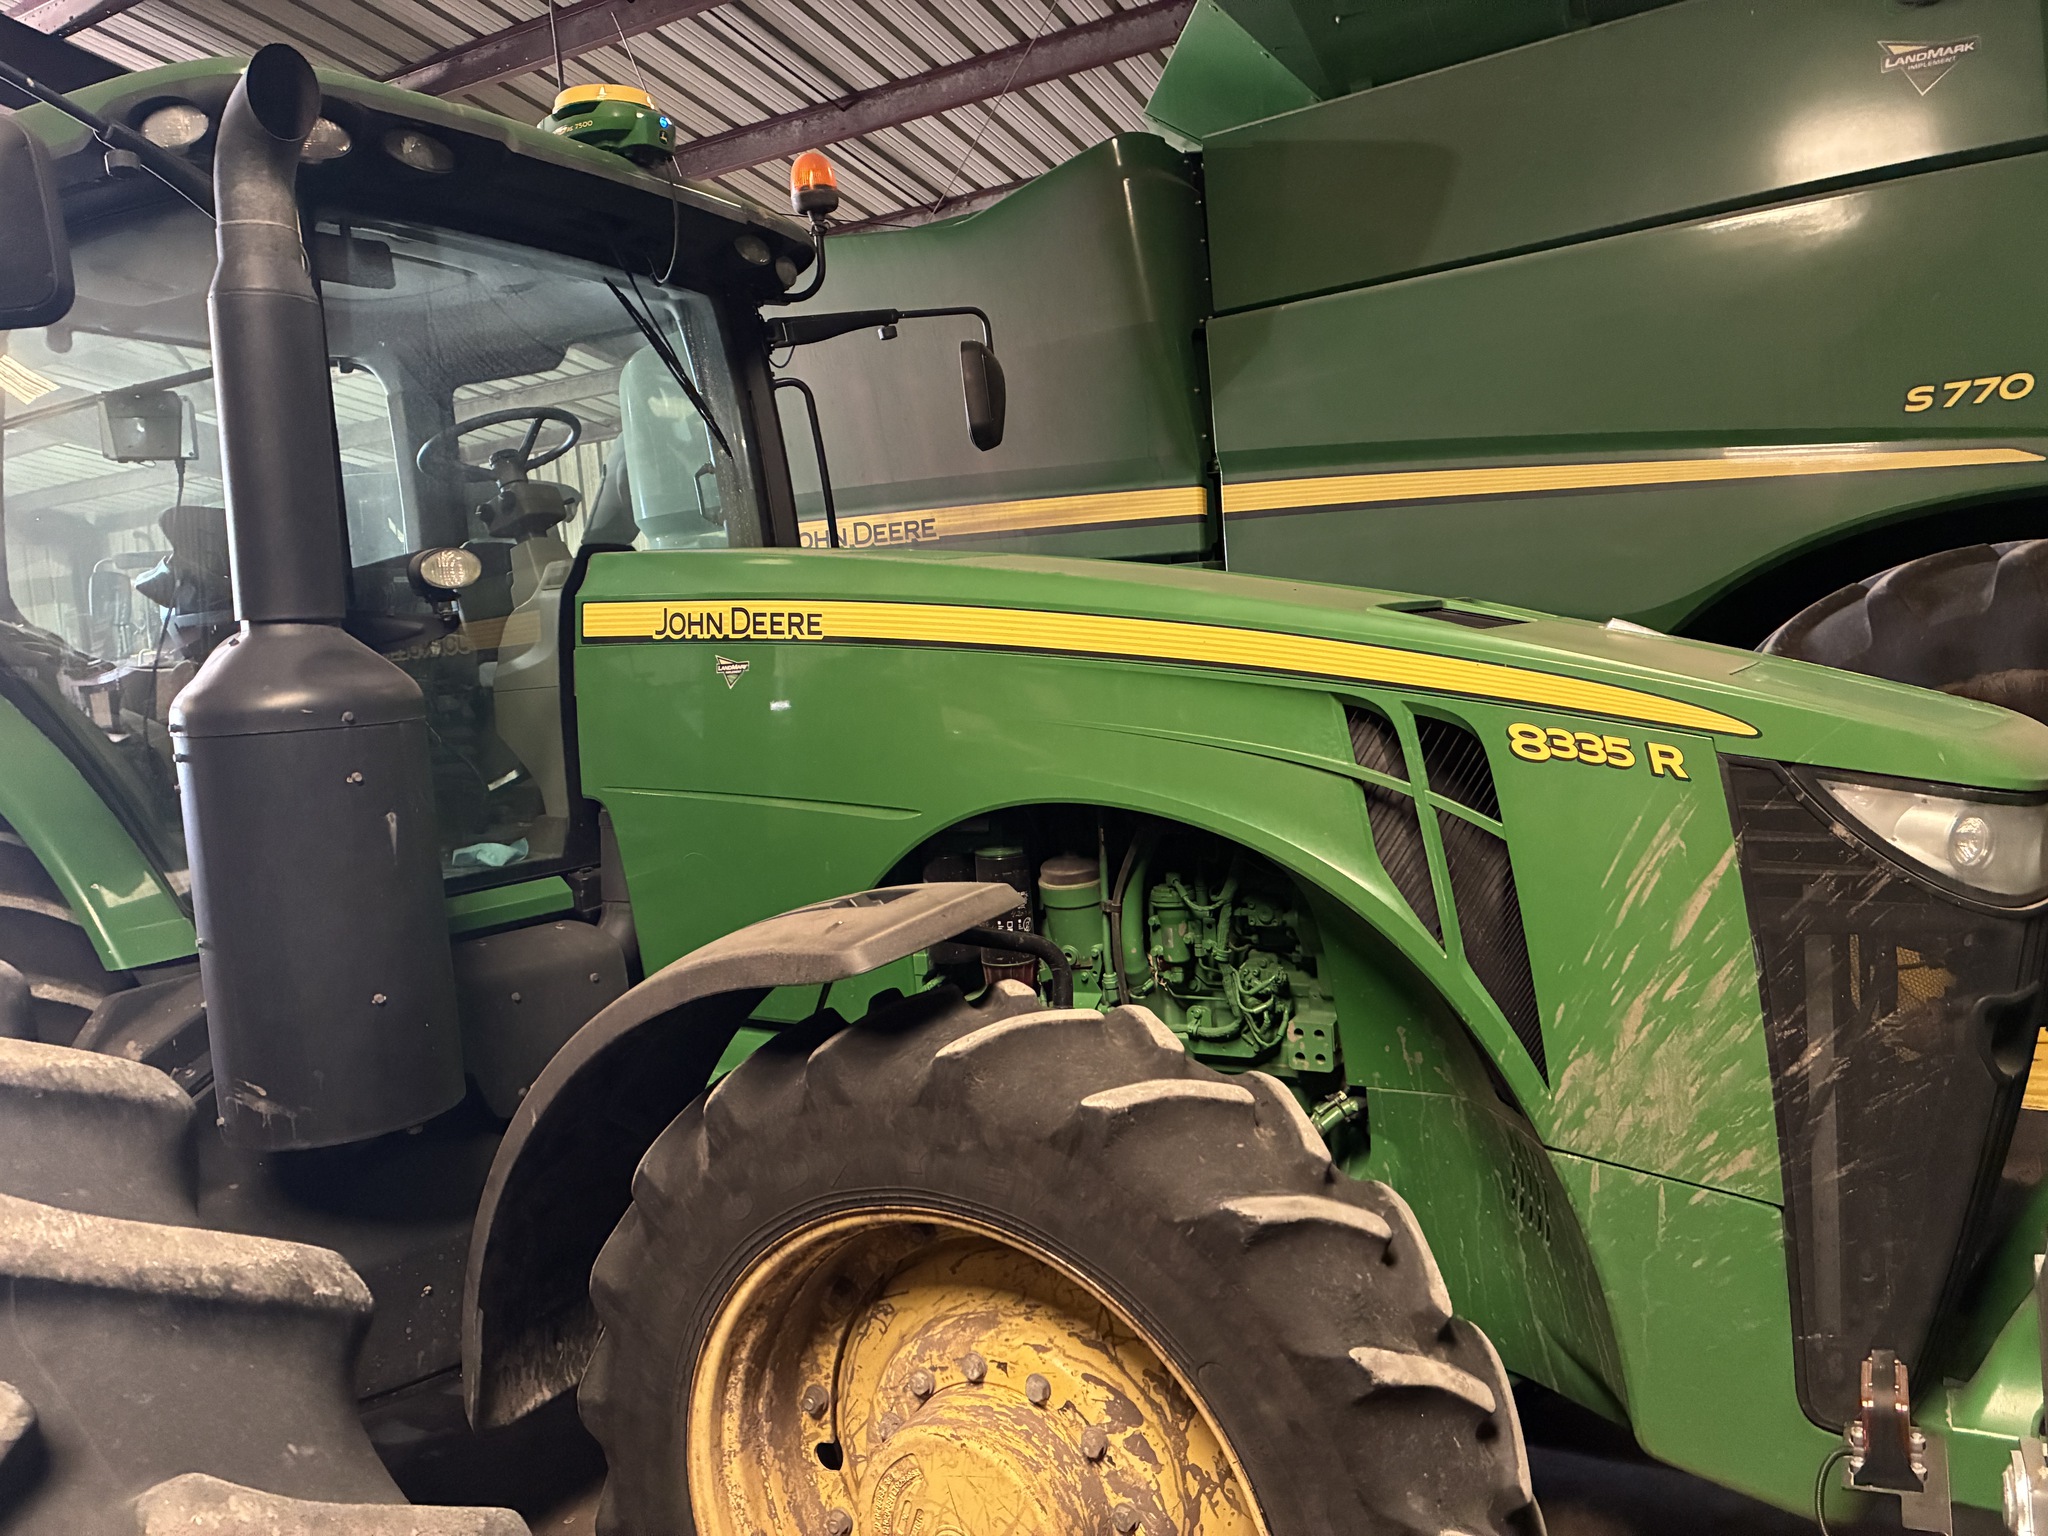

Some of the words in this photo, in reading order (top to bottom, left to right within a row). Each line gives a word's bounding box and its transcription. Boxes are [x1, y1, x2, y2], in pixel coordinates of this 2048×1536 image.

[1884, 42, 1975, 68] LANDMARK
[1908, 55, 1957, 70] IMPLEMENT
[574, 119, 594, 130] 7500
[1904, 385, 1935, 413] S
[1942, 372, 2035, 408] 770
[800, 527, 848, 548] OHN
[853, 518, 936, 545] DEERE
[655, 608, 723, 635] JOHN
[731, 607, 823, 635] DEERE
[1506, 722, 1636, 769] 8335
[1645, 741, 1692, 782] R
